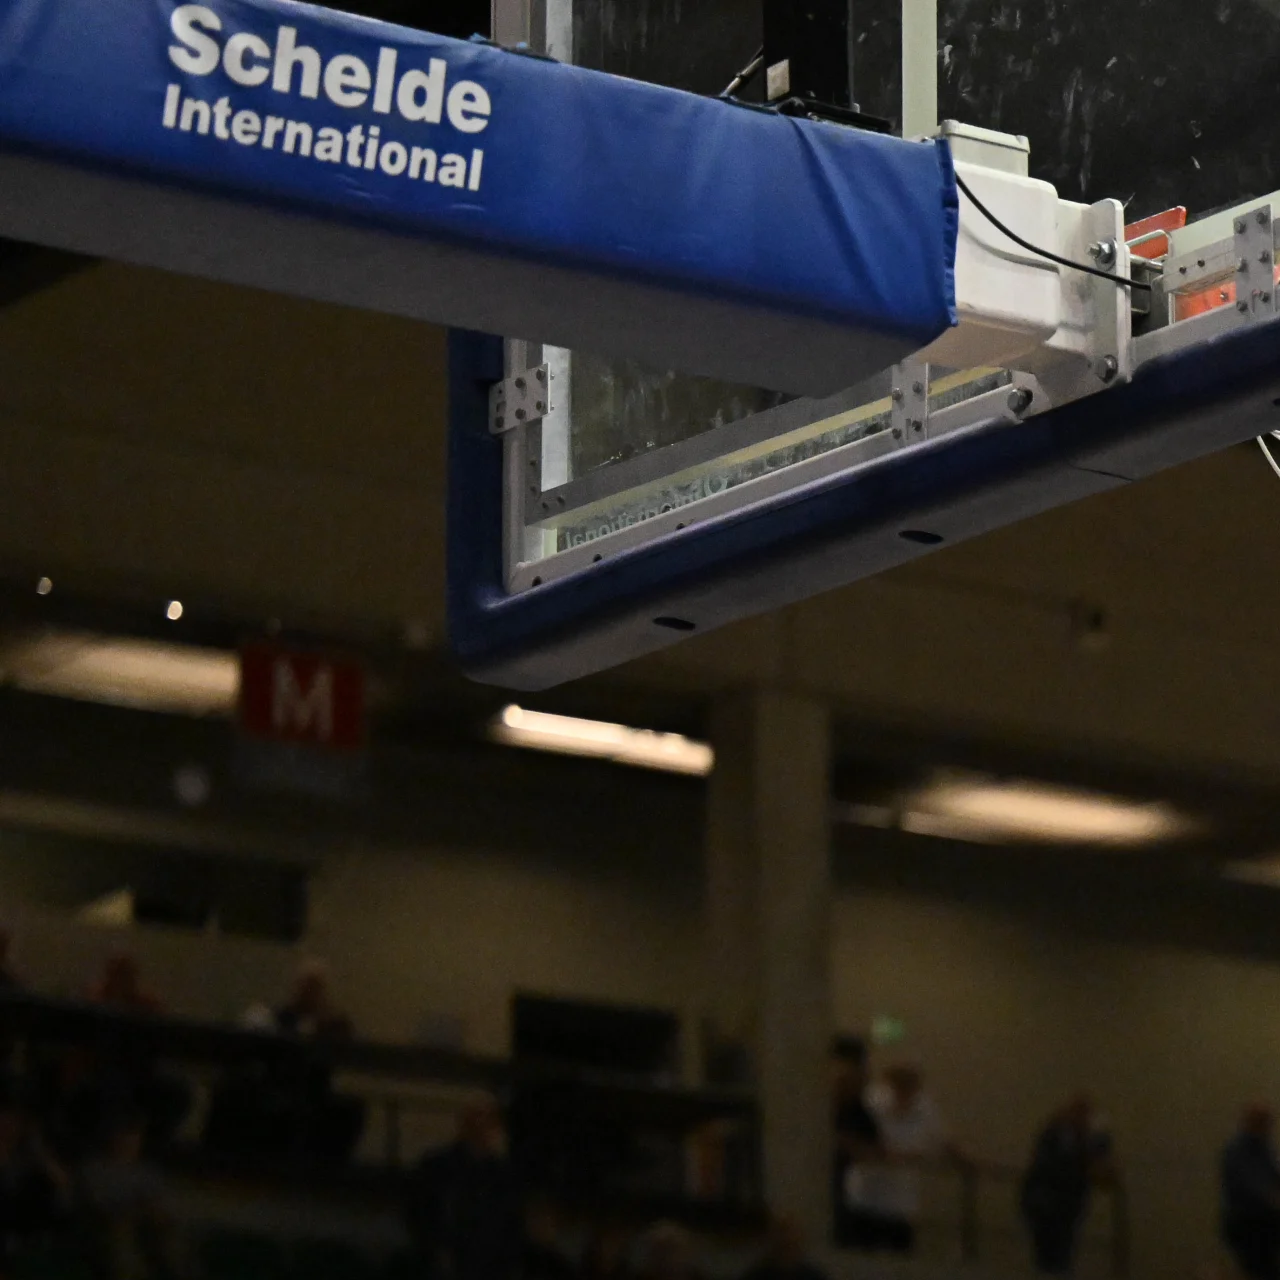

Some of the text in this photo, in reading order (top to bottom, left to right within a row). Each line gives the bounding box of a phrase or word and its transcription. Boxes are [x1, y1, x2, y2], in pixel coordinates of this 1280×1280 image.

[168, 4, 491, 133] Schelde
[162, 84, 484, 191] International
[271, 657, 336, 740] M
